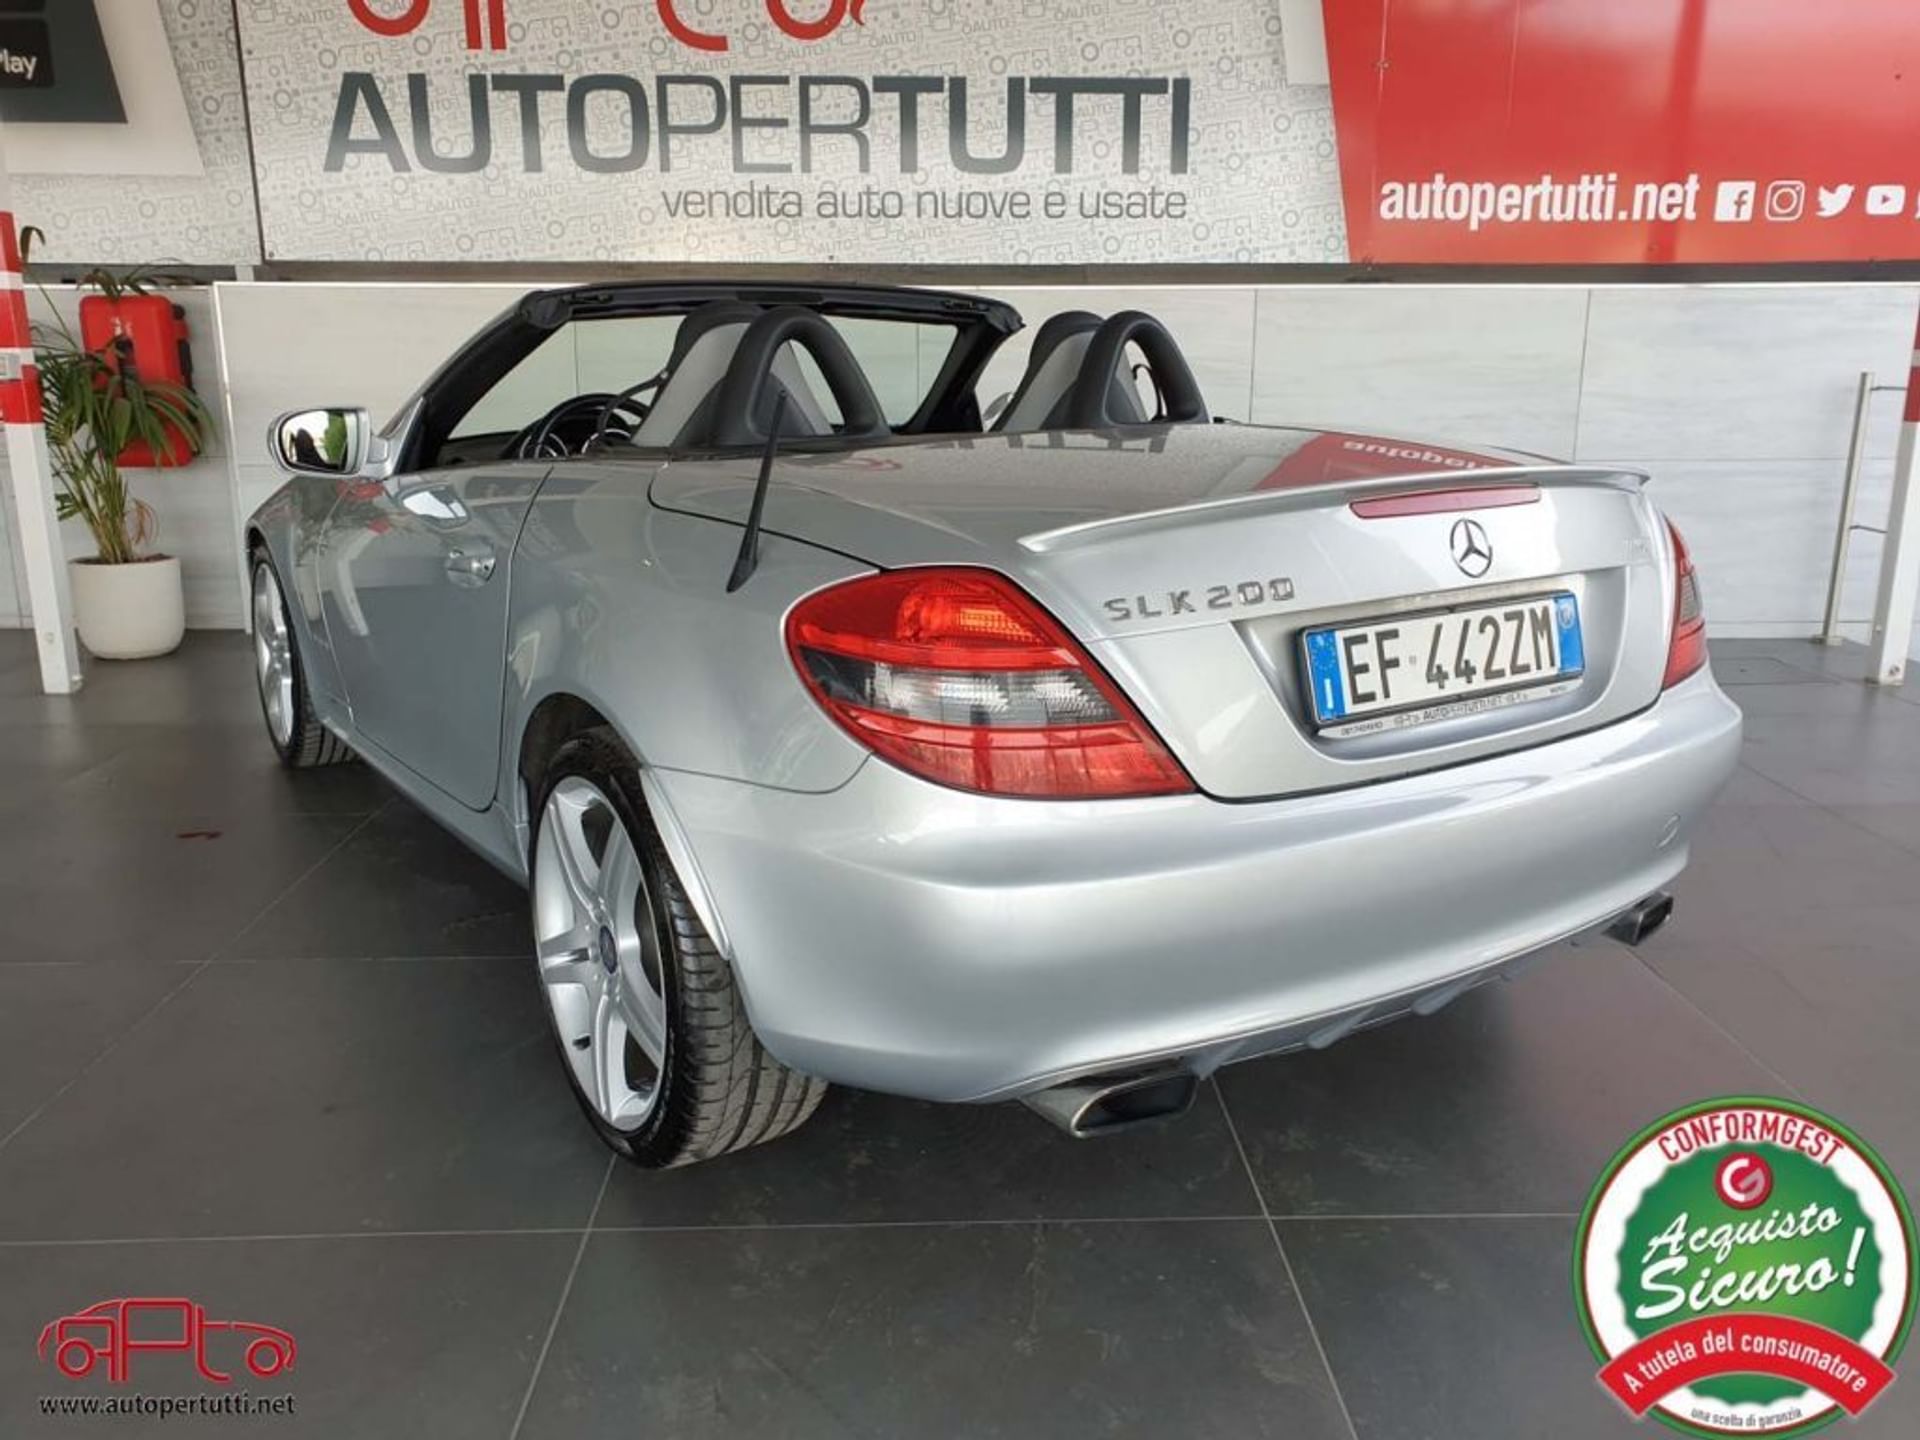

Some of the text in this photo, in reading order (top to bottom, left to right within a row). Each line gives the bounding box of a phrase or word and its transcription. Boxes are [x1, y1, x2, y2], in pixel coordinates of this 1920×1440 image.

[0, 48, 37, 80] lay
[323, 71, 1190, 174] AUTOPERTUTTI
[661, 180, 1188, 219] vendita auto nuove e usate
[1380, 172, 1700, 231] autopertutti.net
[1104, 577, 1295, 622] SLK 200
[1342, 606, 1557, 704] EF 442ZM
